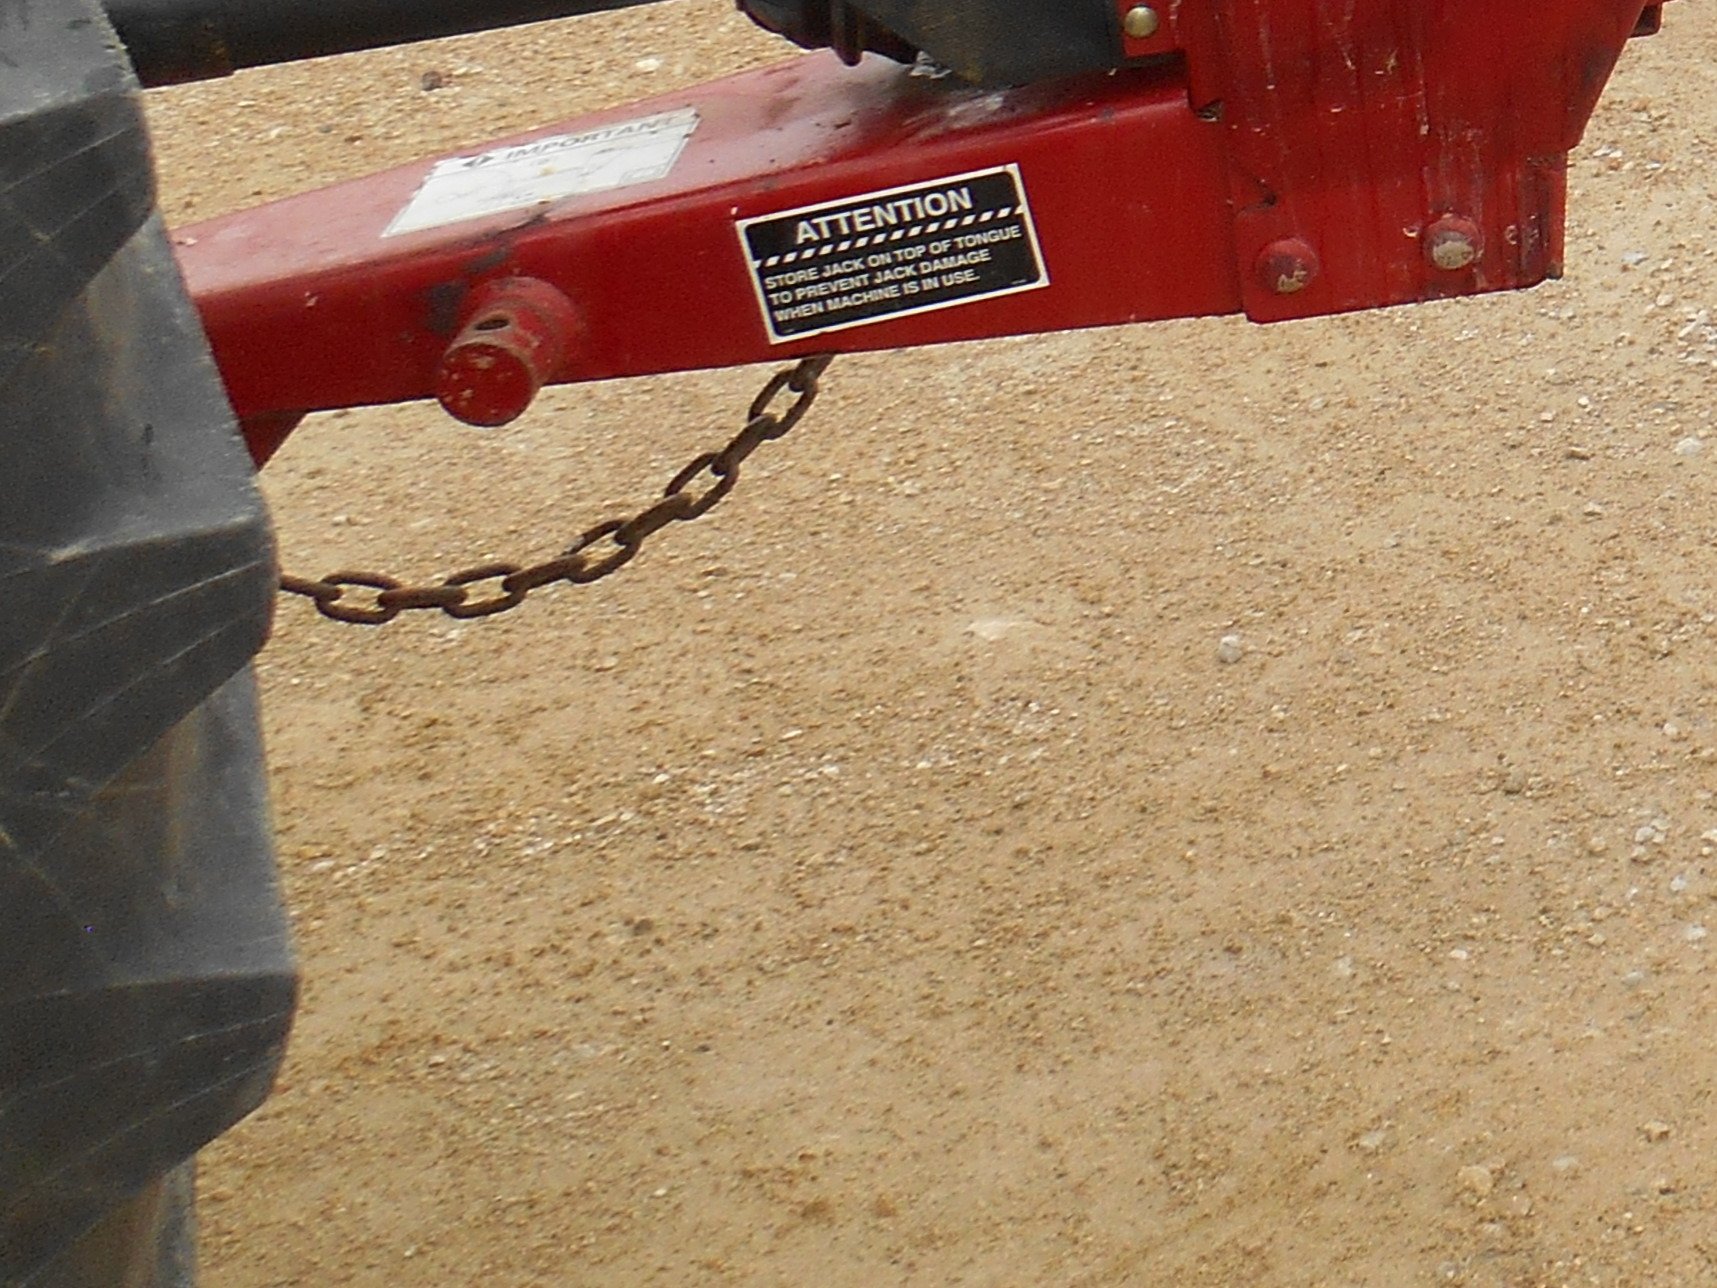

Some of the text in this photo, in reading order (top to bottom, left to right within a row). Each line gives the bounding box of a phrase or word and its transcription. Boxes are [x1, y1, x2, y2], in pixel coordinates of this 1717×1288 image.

[506, 116, 676, 159] IMPORTANT
[795, 187, 973, 245] ATTENTION
[763, 224, 1022, 290] STORE JACK ON TOP OF TONGUE
[768, 247, 992, 306] TO PREVENT JACK DAMAGE
[773, 267, 980, 322] WHEN MACHINE IS IN USE.
